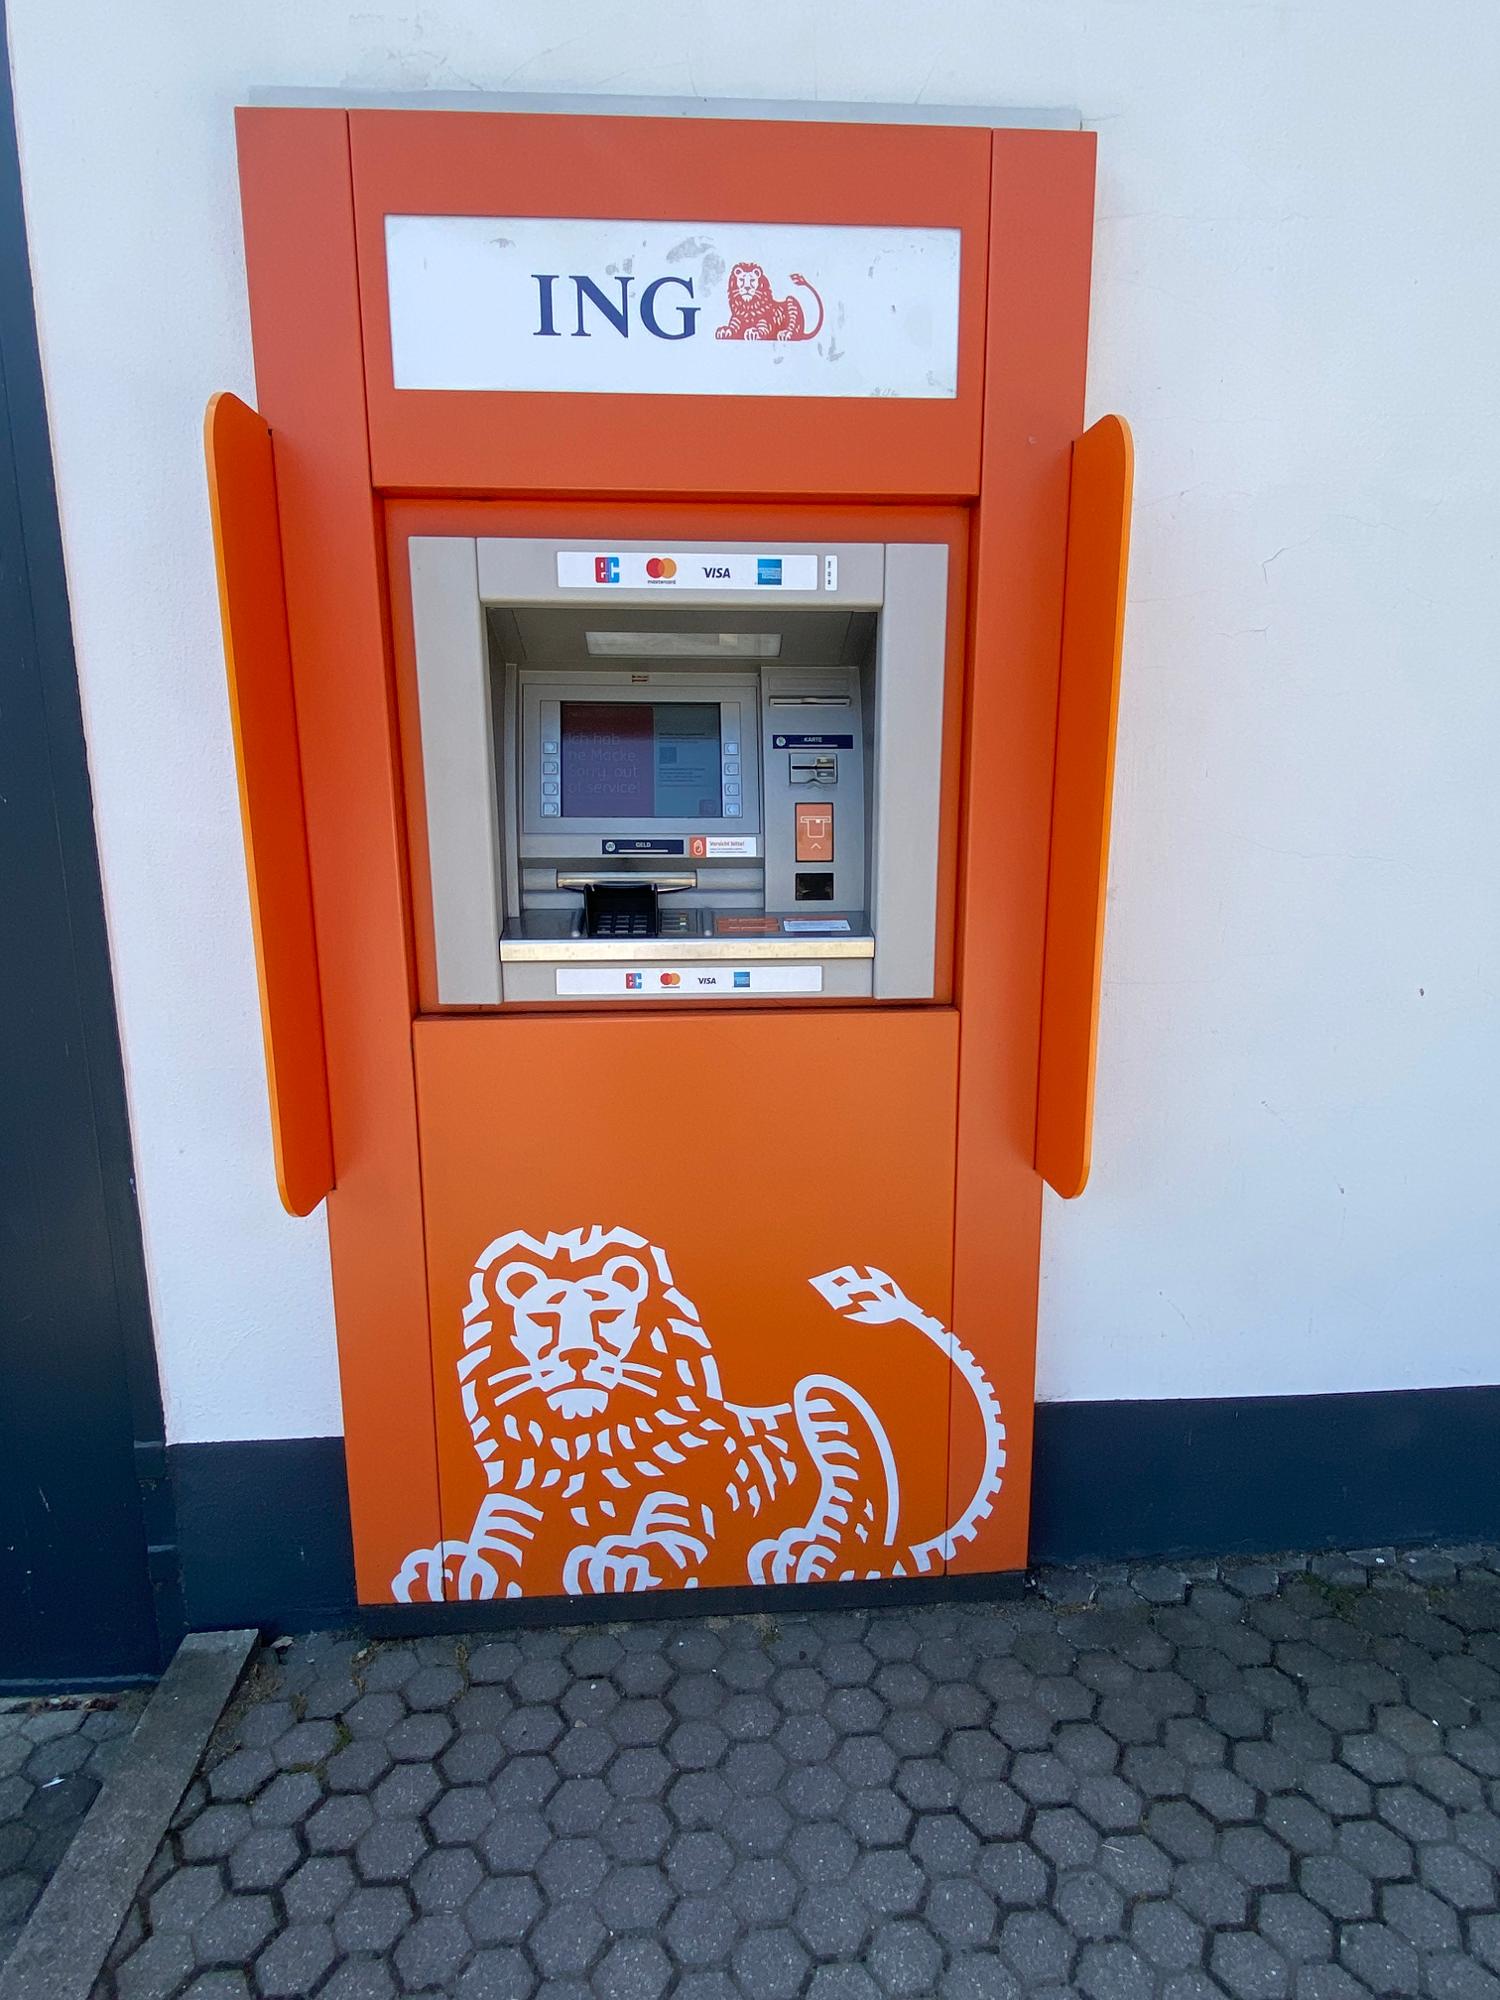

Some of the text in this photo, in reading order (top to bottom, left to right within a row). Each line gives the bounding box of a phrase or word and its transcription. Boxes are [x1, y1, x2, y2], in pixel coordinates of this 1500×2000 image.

[531, 274, 701, 340] ING
[703, 567, 731, 579] VISA
[614, 765, 639, 778] out
[698, 977, 717, 985] VISA
